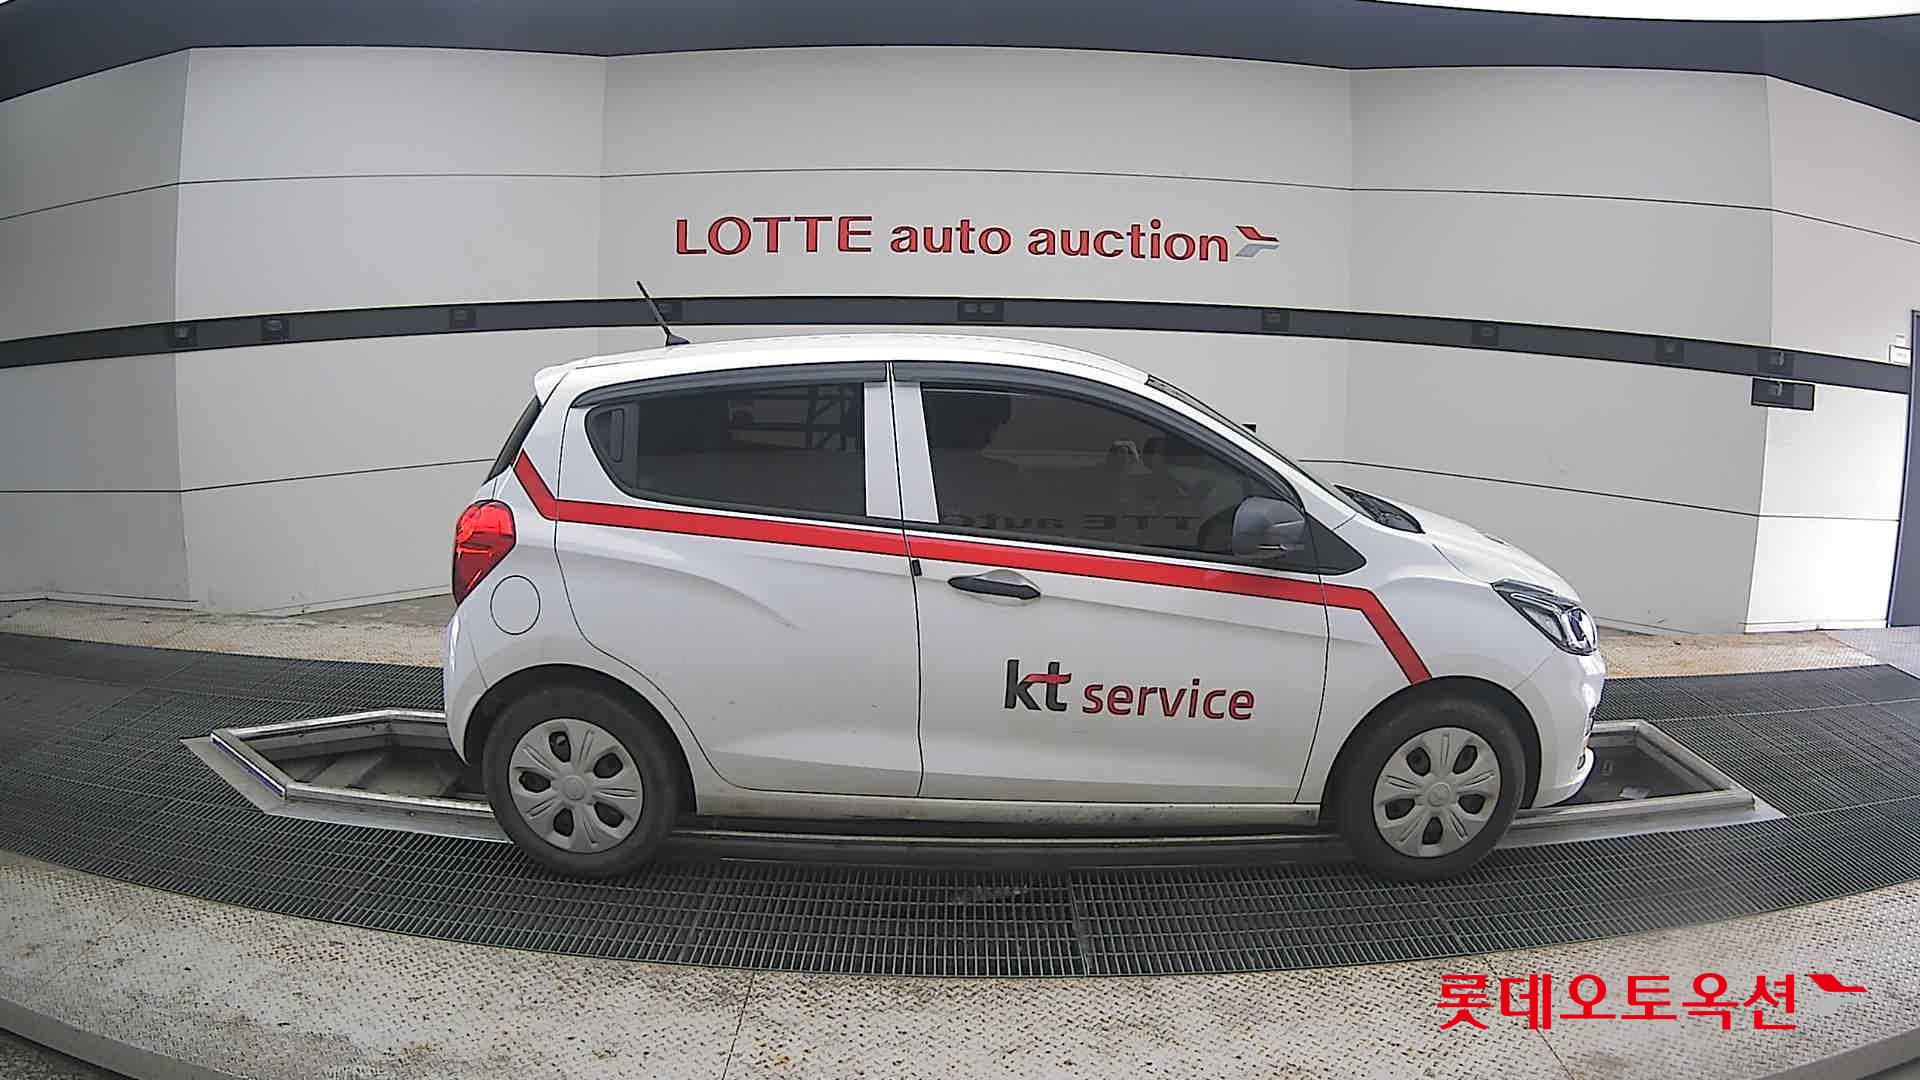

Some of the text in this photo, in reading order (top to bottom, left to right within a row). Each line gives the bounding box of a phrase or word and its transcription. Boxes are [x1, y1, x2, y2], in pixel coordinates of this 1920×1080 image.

[676, 216, 1230, 263] LOTTE auto auction
[1004, 658, 1256, 722] kt service
